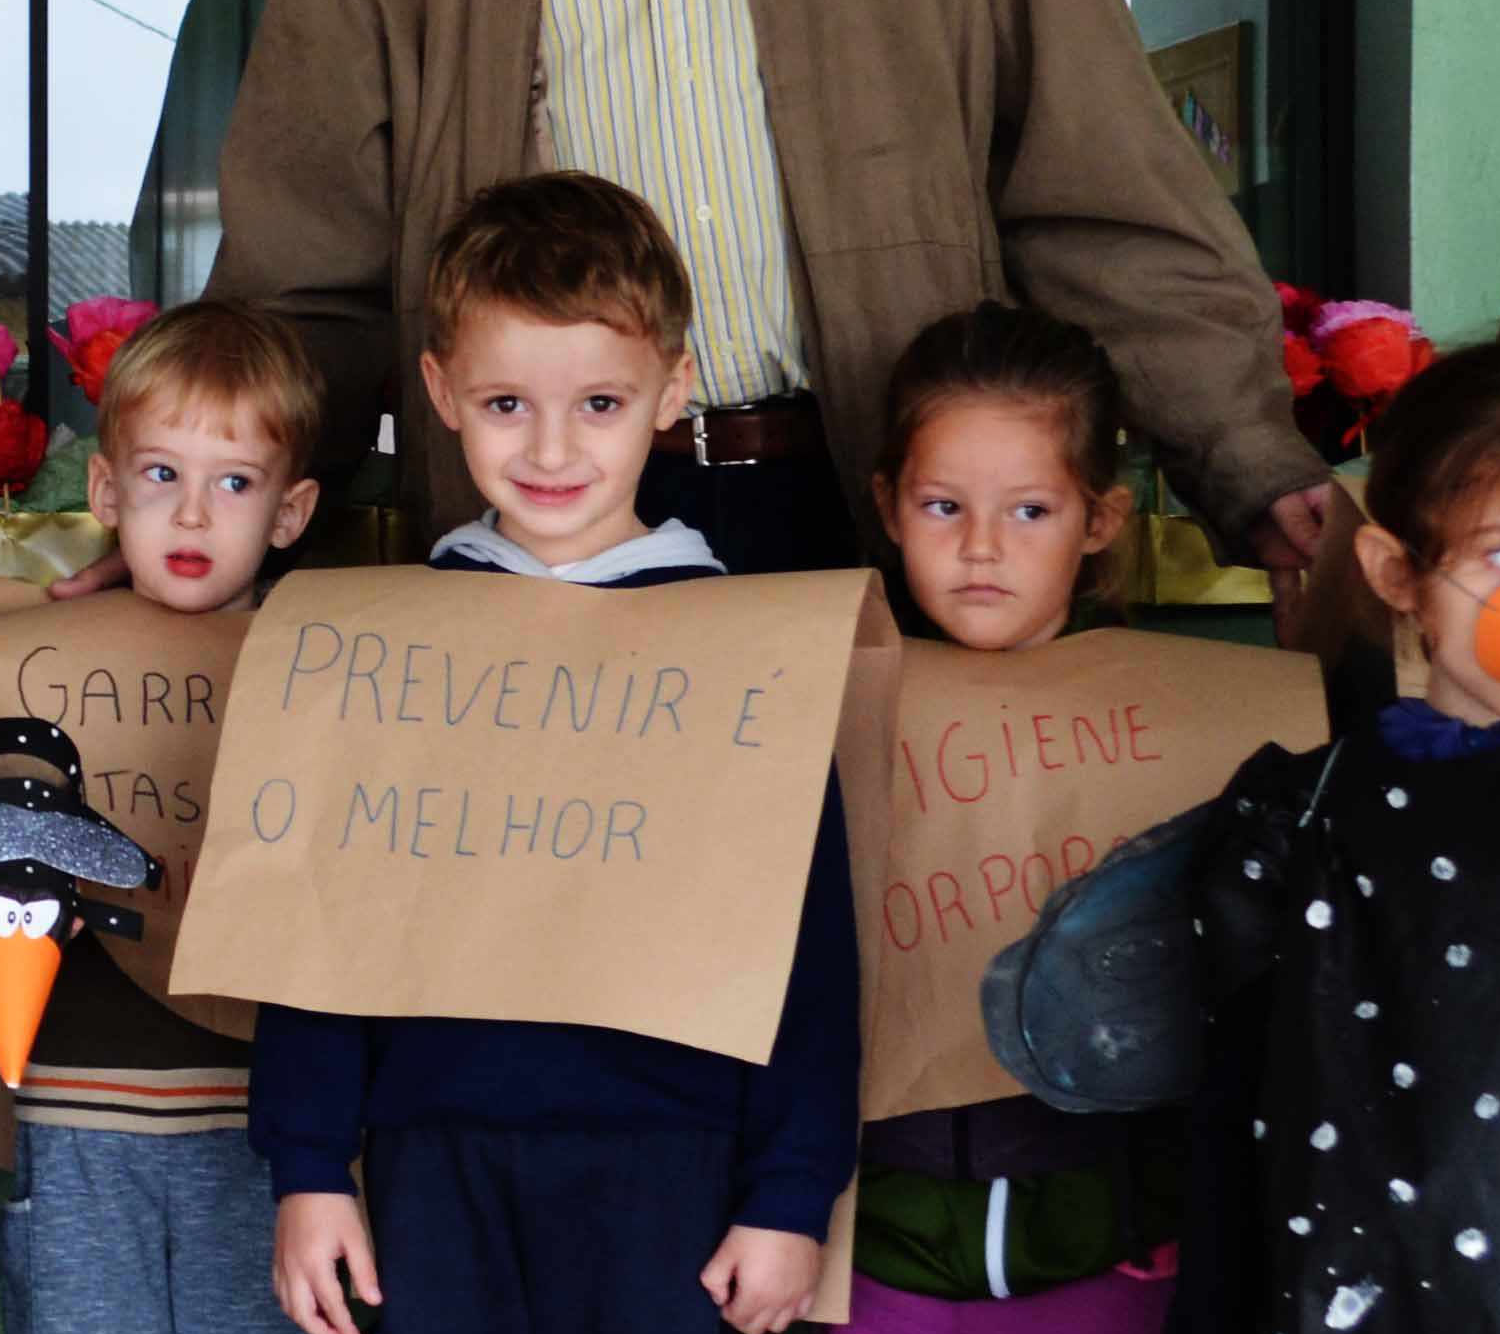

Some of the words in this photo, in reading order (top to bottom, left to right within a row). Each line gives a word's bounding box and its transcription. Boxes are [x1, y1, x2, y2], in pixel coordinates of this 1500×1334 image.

[282, 620, 693, 739] PREVENIR
[731, 667, 787, 749] É
[249, 775, 299, 845] O
[337, 778, 650, 863] MELHOR
